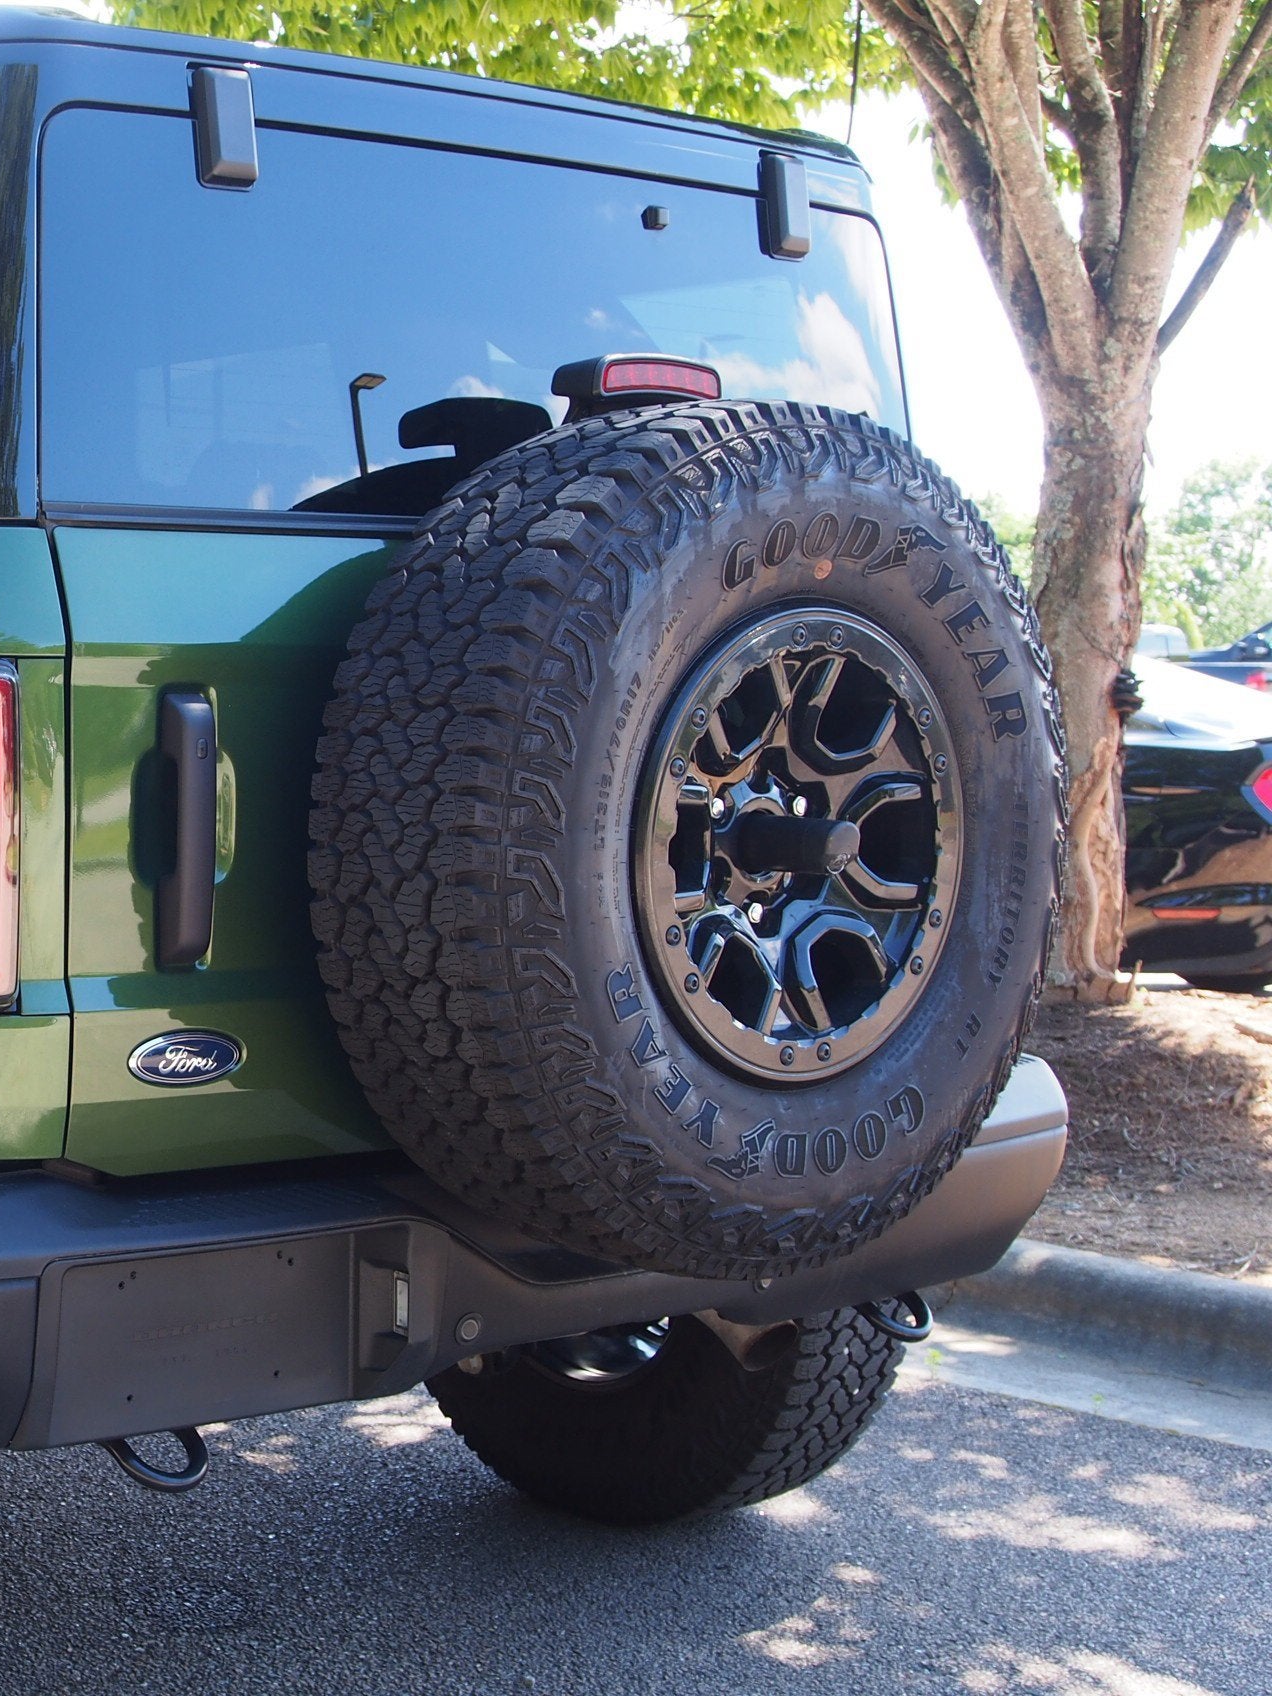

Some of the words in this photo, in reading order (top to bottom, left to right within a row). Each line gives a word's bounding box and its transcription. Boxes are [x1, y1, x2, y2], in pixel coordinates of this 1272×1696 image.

[982, 802, 1029, 994] TERRITORY
[158, 1044, 218, 1074] Ford
[954, 1010, 983, 1061] RT
